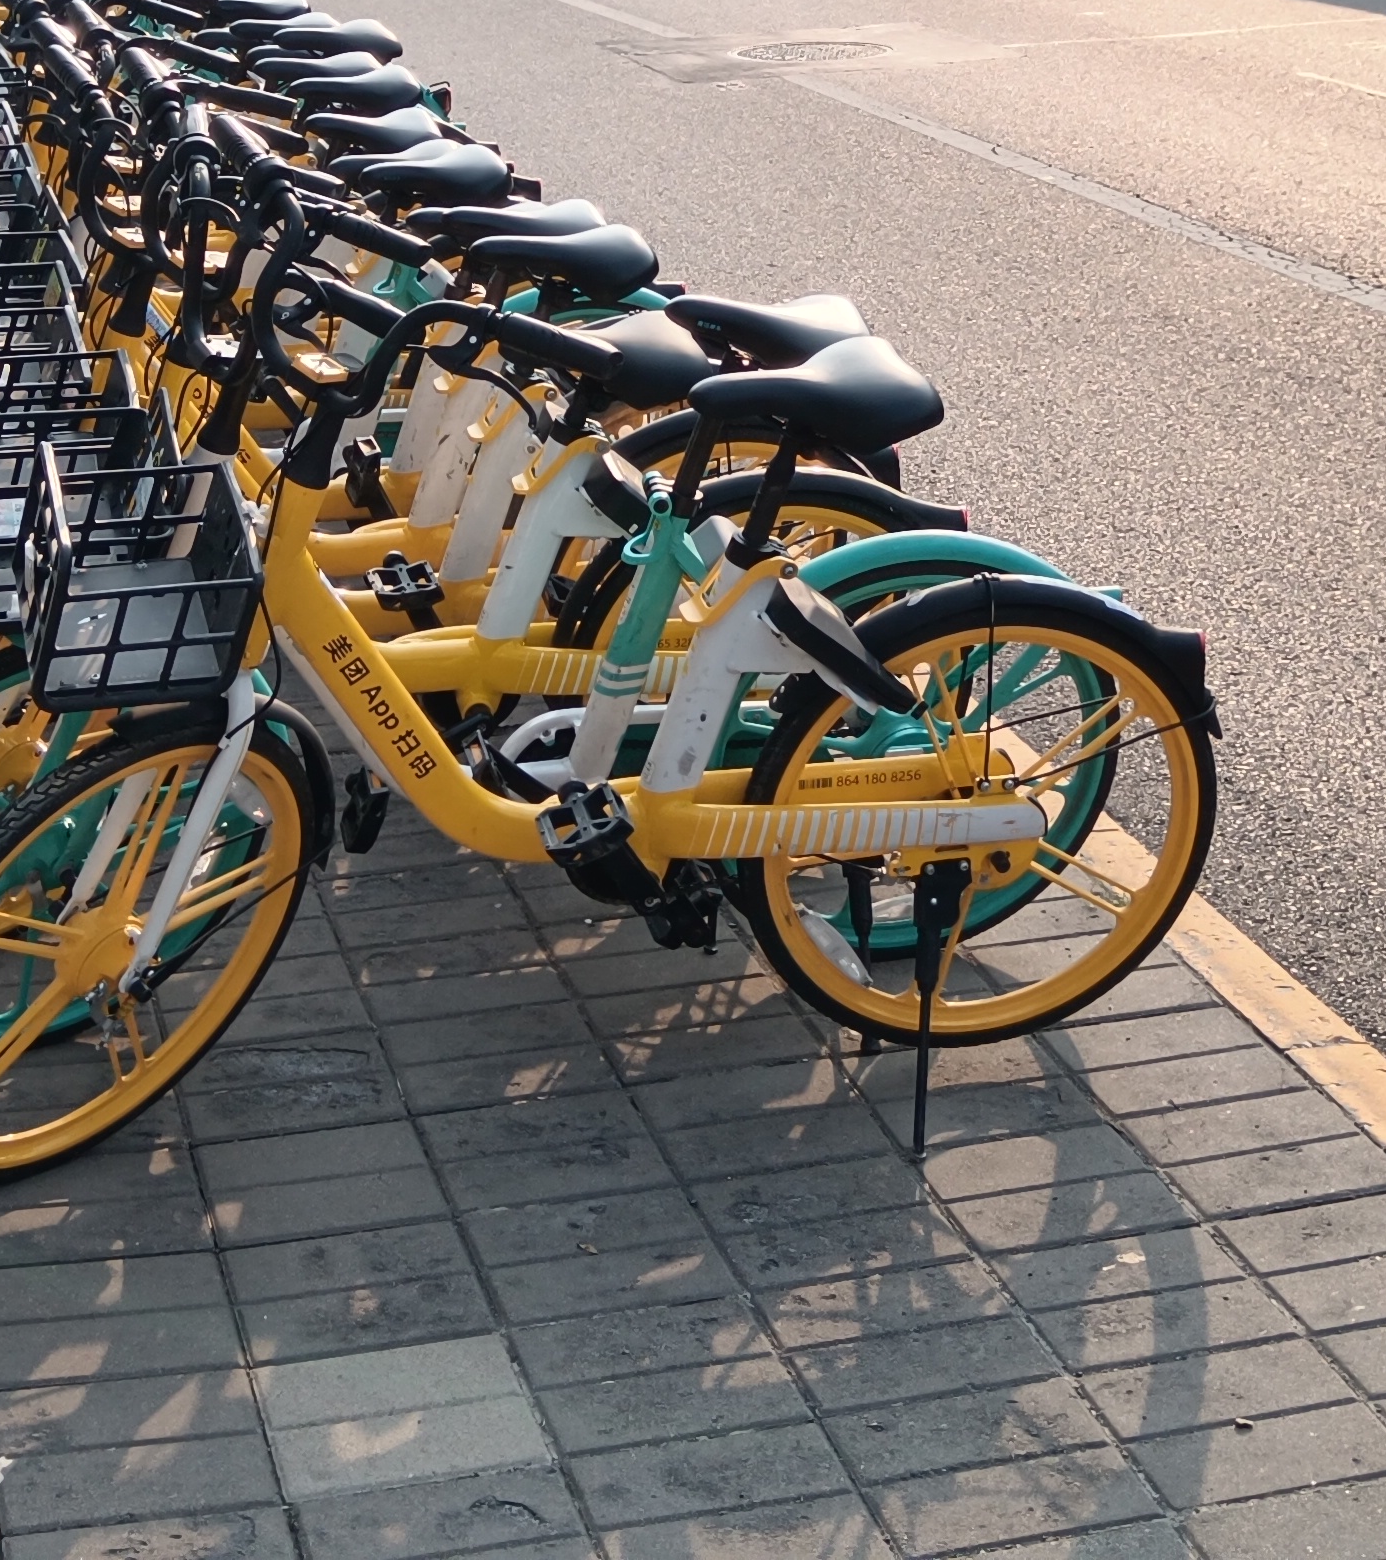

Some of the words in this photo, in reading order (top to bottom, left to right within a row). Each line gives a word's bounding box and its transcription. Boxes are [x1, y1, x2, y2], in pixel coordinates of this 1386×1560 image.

[836, 774, 859, 787] 864
[865, 772, 887, 785] 180
[890, 769, 922, 783] 8256
